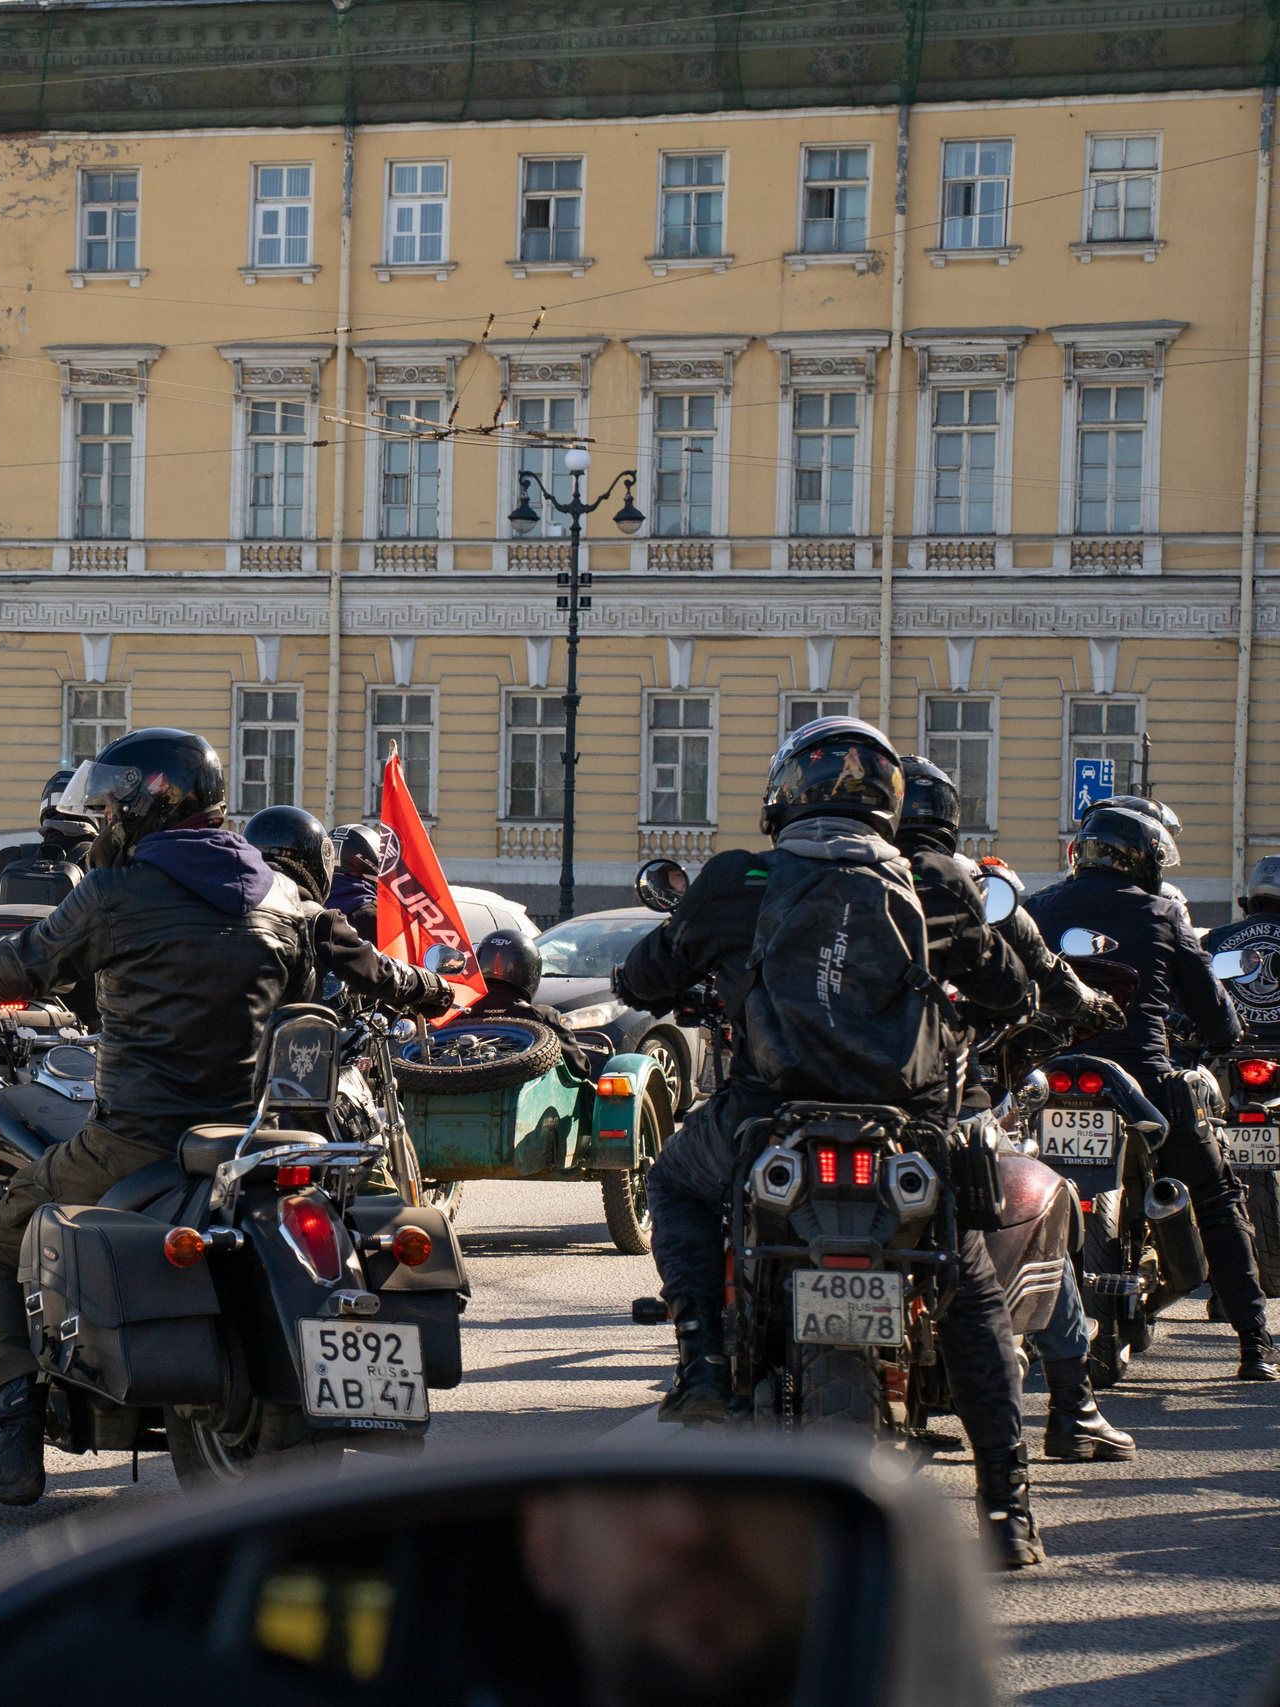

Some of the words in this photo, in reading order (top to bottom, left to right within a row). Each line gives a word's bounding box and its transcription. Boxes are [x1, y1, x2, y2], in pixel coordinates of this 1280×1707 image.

[490, 938, 512, 946] agv
[1221, 924, 1271, 950] NORMANS
[832, 931, 849, 968] KEY
[816, 946, 833, 1011] STREET
[829, 970, 842, 995] OF
[1235, 1002, 1280, 1021] PETERS
[1051, 1111, 1104, 1129] 0358
[1231, 1129, 1272, 1142] 7070
[1083, 1139, 1109, 1156] 47
[1256, 1149, 1277, 1163] 10
[811, 1274, 885, 1300] 4808
[848, 1302, 872, 1312] RUS
[858, 1314, 894, 1340] 78
[319, 1329, 404, 1365] 5892
[367, 1365, 397, 1378] RUS
[380, 1379, 415, 1415] 47
[349, 1418, 407, 1431] HONDA
